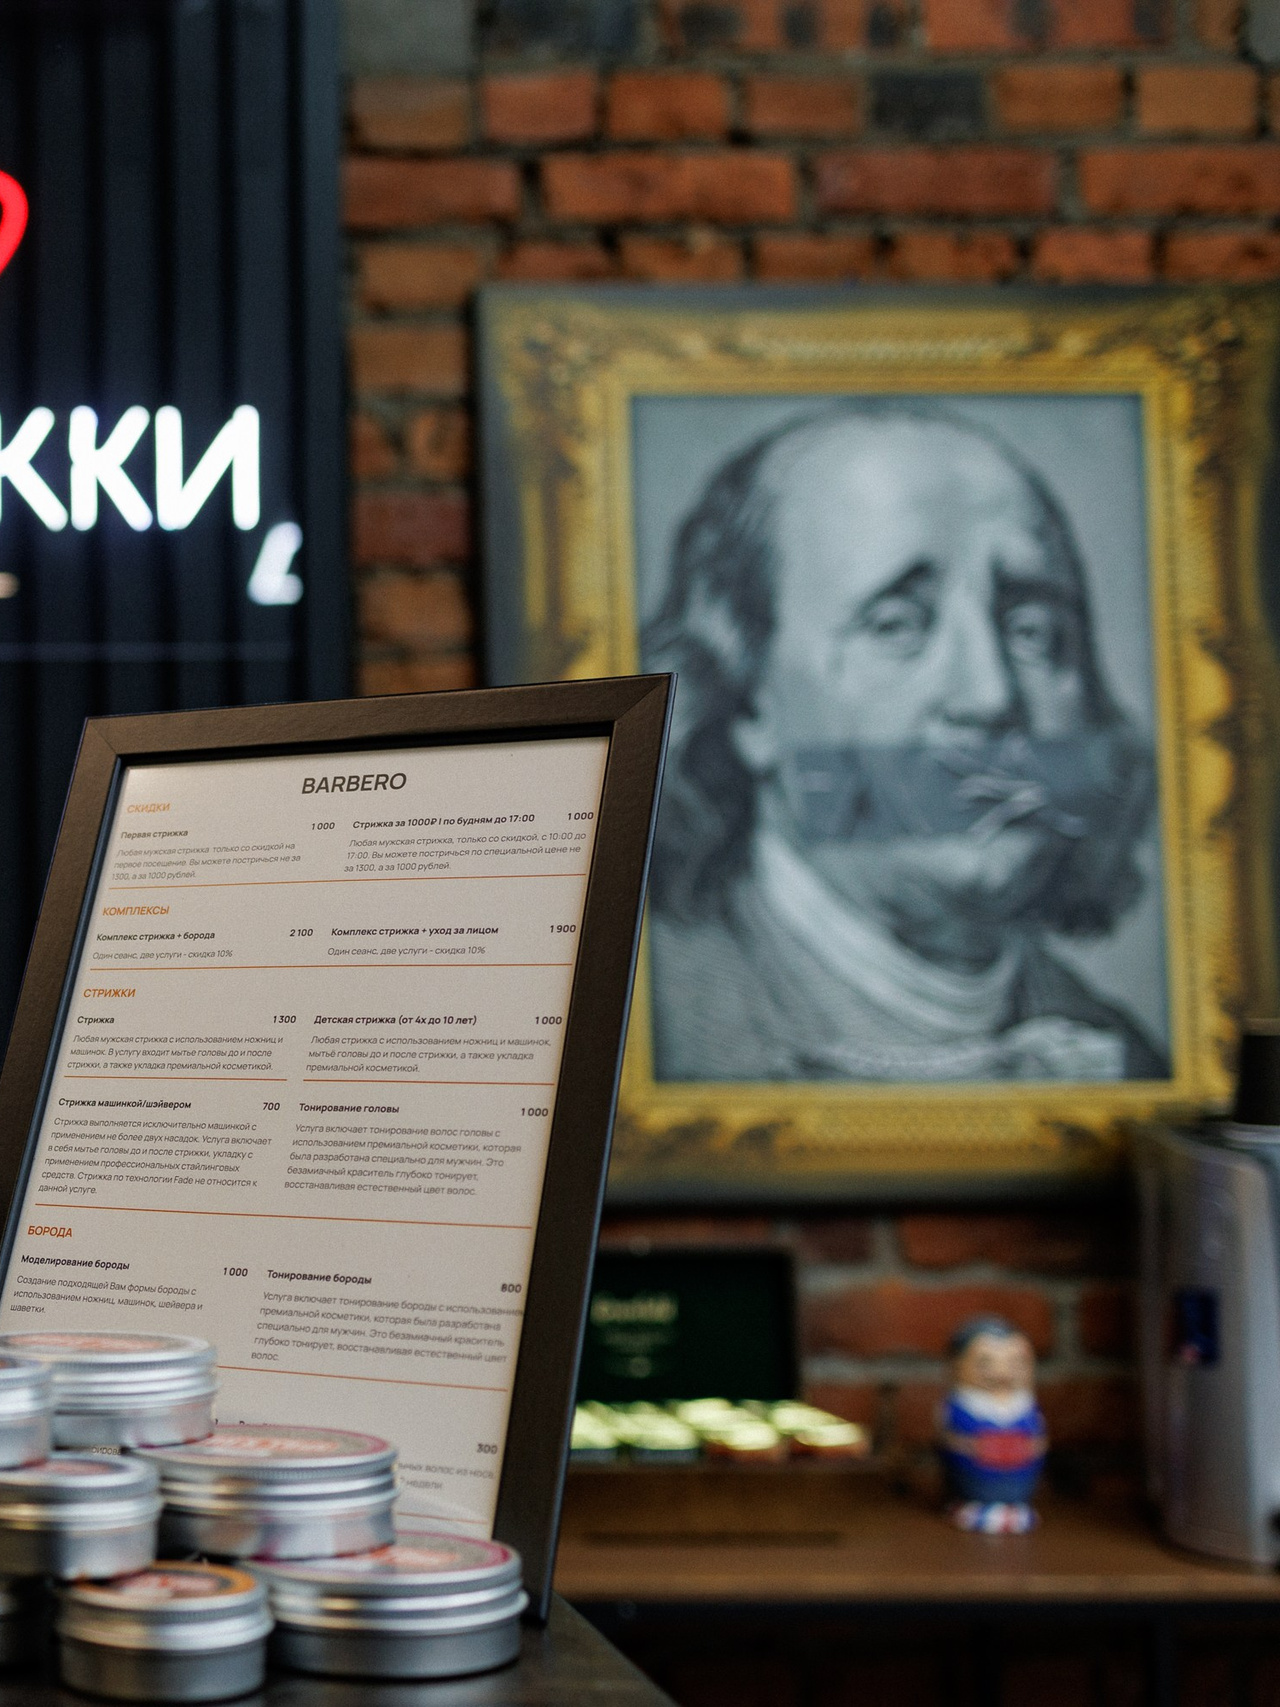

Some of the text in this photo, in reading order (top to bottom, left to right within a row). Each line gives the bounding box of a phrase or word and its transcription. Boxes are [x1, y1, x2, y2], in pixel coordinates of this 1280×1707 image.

[301, 773, 407, 794] BARBERO
[128, 803, 171, 814] СКИДКИ
[353, 818, 394, 830] Стрижка
[457, 814, 493, 826] будням
[493, 816, 507, 824] до
[509, 813, 535, 822] 17:00
[121, 830, 189, 840] Первая стрижка
[349, 838, 378, 847] Любая
[379, 838, 415, 848] мужская
[549, 831, 573, 840] 10:00
[574, 832, 587, 840] до
[371, 849, 384, 858] Вы
[419, 849, 470, 859] постричься
[483, 845, 544, 856] специальной
[544, 847, 567, 855] цене
[397, 861, 417, 870] 1000
[102, 906, 171, 915] КОМПЛЕКСЫ
[97, 932, 138, 940] Комплекс
[139, 933, 176, 942] стрижка
[183, 931, 216, 941] борода
[331, 927, 377, 935] Комплекс
[379, 928, 420, 937] стрижка
[428, 928, 452, 936] уход
[466, 927, 499, 935] лицом
[93, 951, 113, 960] Один
[155, 951, 182, 960] услуги
[188, 951, 216, 959] скидка
[217, 949, 233, 957] 10%
[327, 946, 350, 956] Один
[380, 948, 397, 956] две
[398, 948, 428, 956] услуги
[435, 947, 466, 955] скидка
[468, 945, 486, 954] 10%
[83, 988, 137, 997] СТРИЖКИ
[77, 1015, 115, 1025] Стрижка
[314, 1014, 354, 1024] Детская
[355, 1017, 396, 1026] стрижка
[398, 1015, 413, 1026] (от
[427, 1017, 441, 1025] до
[442, 1015, 455, 1024] 10
[456, 1015, 478, 1026] лет)
[74, 1034, 100, 1042] Любая
[100, 1036, 134, 1044] мужская
[311, 1035, 340, 1044] Любая
[341, 1037, 378, 1046] стрижка
[463, 1038, 499, 1046] ножниц
[133, 1062, 166, 1071] укладка
[166, 1061, 222, 1071] премиальной
[306, 1062, 365, 1073] премиальной
[58, 1097, 192, 1110] Стрижка машинкой/шэйвером
[263, 1102, 281, 1110] 700
[300, 1102, 400, 1114] Тонирование головы
[54, 1117, 89, 1127] Стрижка
[207, 1121, 251, 1130] машинкой
[51, 1132, 106, 1141] применением
[117, 1132, 143, 1141] более
[144, 1134, 163, 1143] двух
[202, 1134, 230, 1145] Услуга
[45, 1158, 240, 1171] применением профессиональных стайлинговых
[77, 1171, 113, 1182] Стрижка
[125, 1175, 173, 1183] технологии
[173, 1175, 194, 1184] Fade
[207, 1178, 252, 1186] относится
[38, 1183, 69, 1193] данной
[27, 1225, 74, 1238] БОРОДА
[21, 1255, 130, 1271] Моделирование бороды
[267, 1269, 372, 1285] Тонирование бороды
[16, 1275, 57, 1287] Создание
[57, 1278, 110, 1290] подходящей
[109, 1281, 127, 1290] Вам
[127, 1282, 157, 1294] формы
[157, 1284, 190, 1296] бороды
[500, 1283, 522, 1292] 800
[13, 1292, 82, 1301] использованием
[158, 1298, 196, 1311] шейвера
